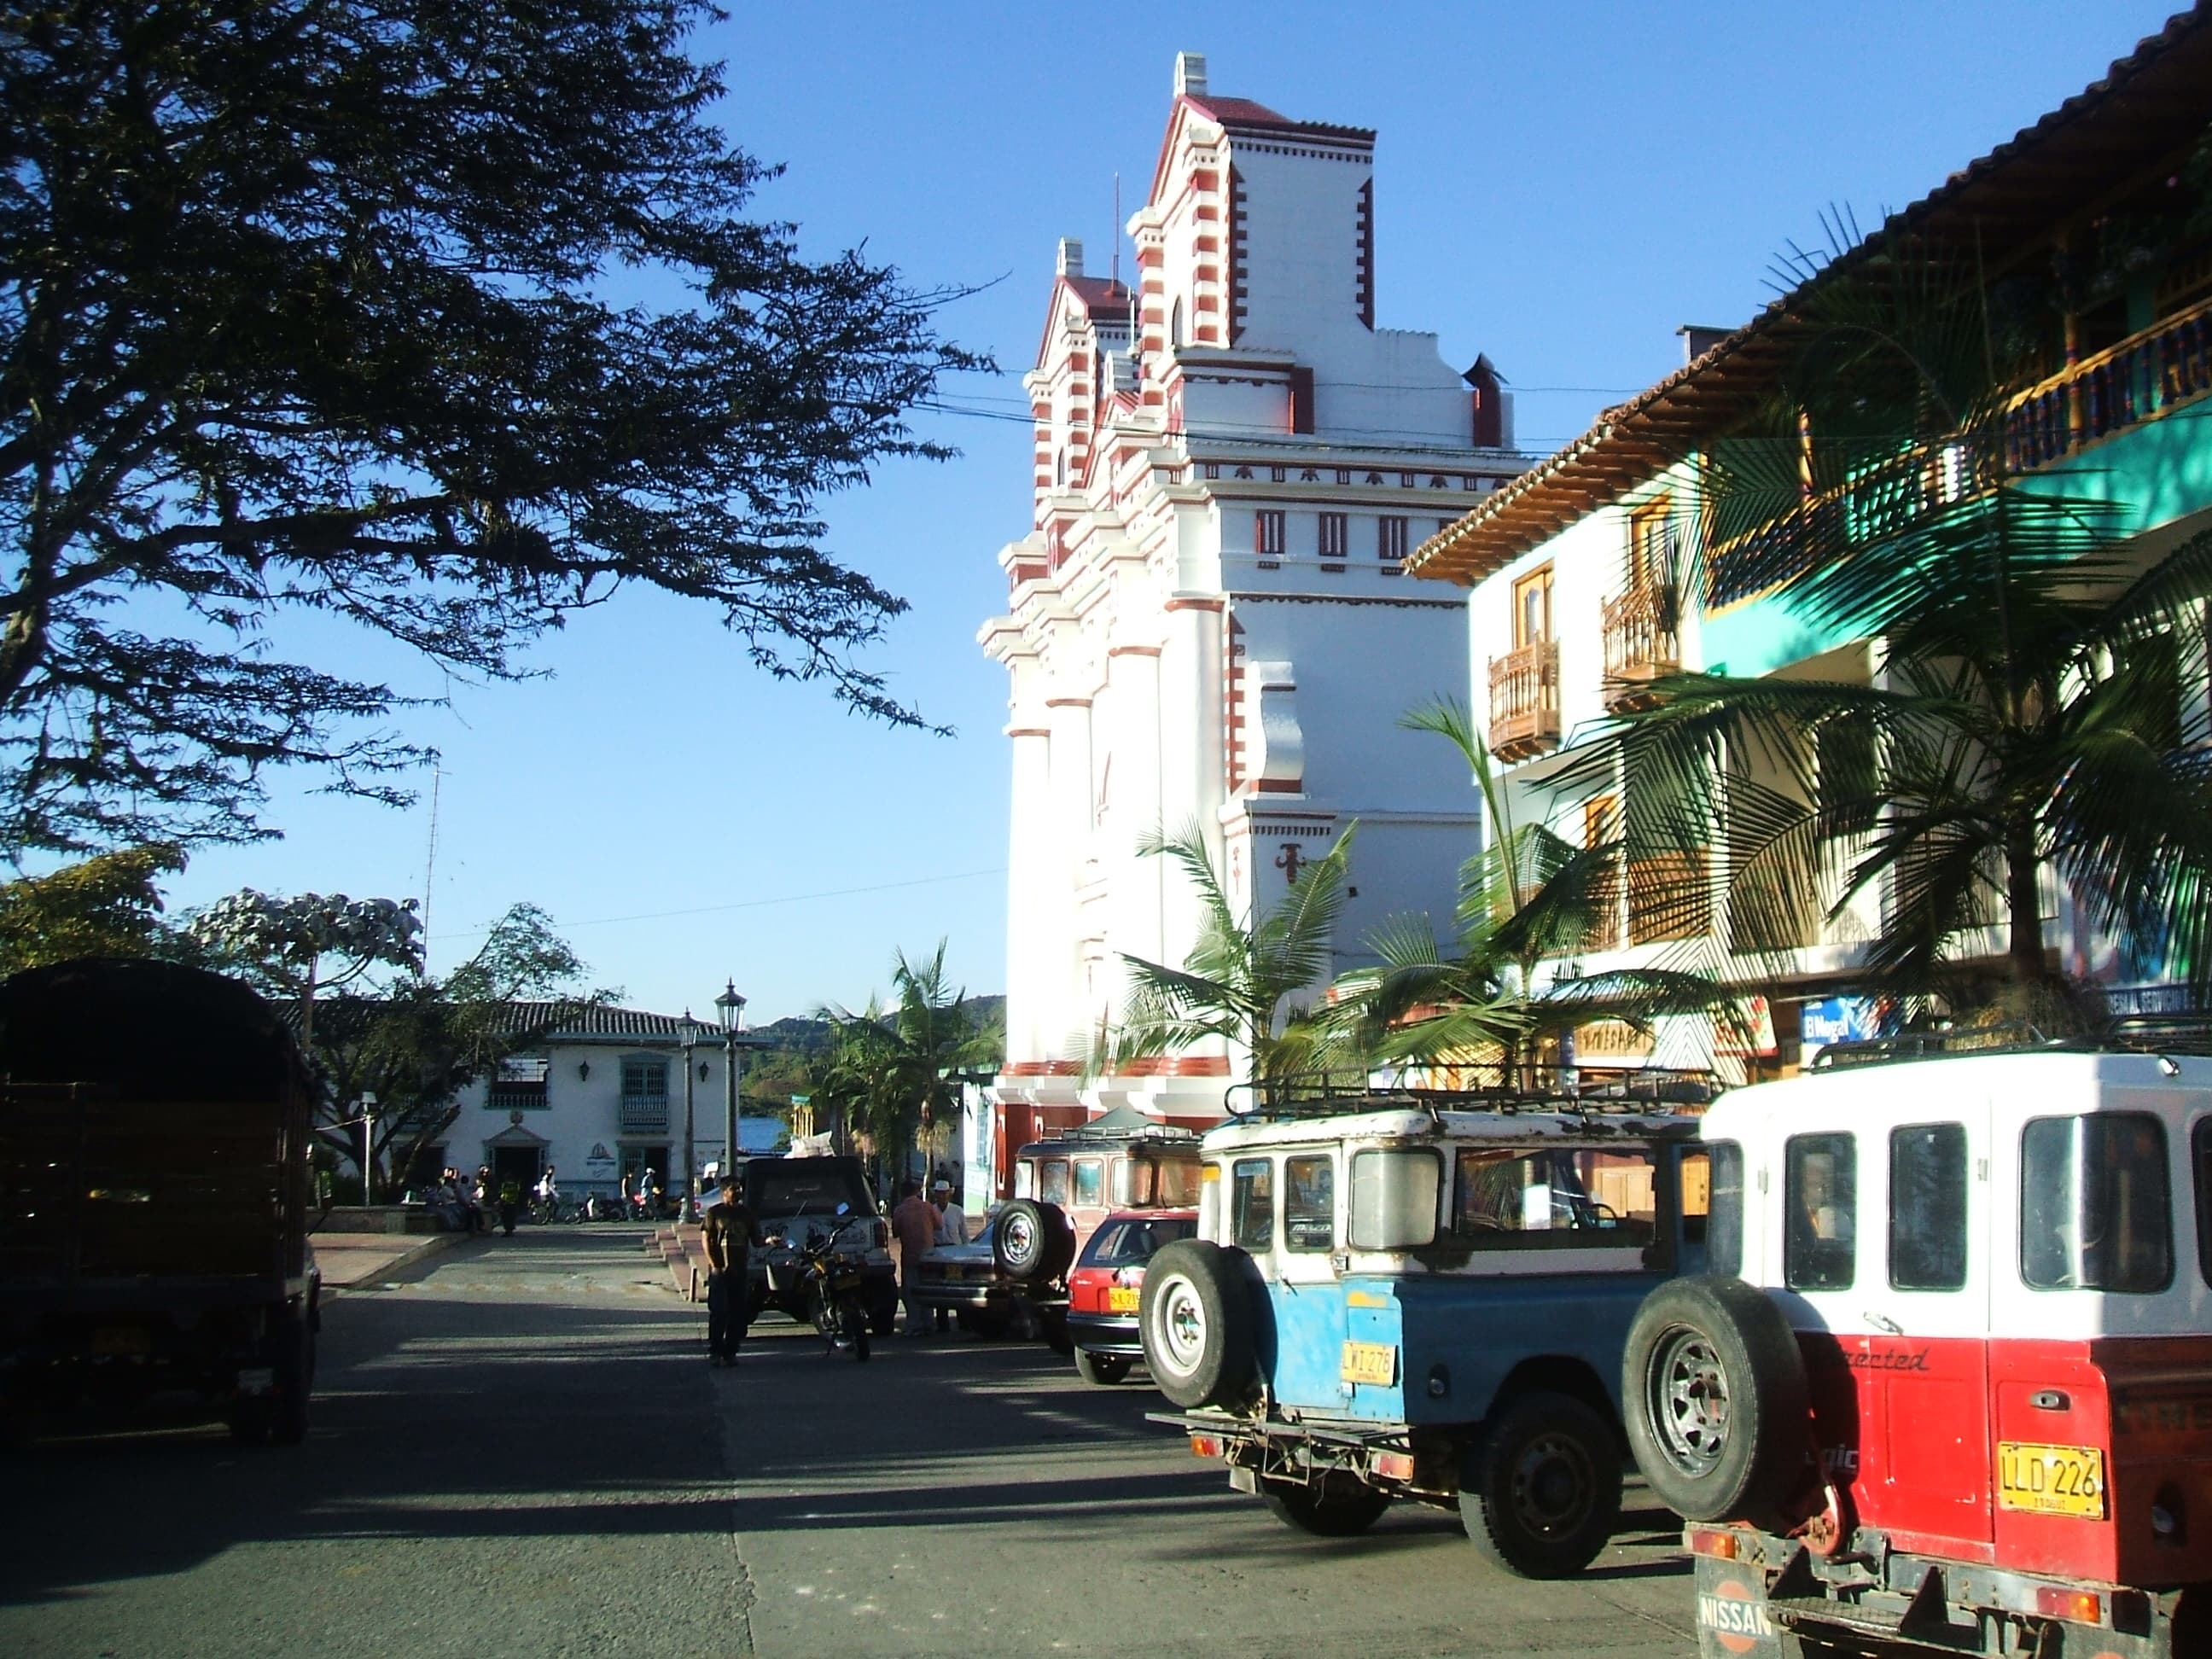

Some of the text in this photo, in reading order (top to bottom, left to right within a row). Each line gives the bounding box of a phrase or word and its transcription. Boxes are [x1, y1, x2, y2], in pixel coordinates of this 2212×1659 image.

[1814, 1015, 1849, 1044] Nogal
[1367, 1351, 1390, 1373] 278
[2001, 1455, 2096, 1498] LLD 226
[1700, 1596, 1773, 1637] NISSAN
